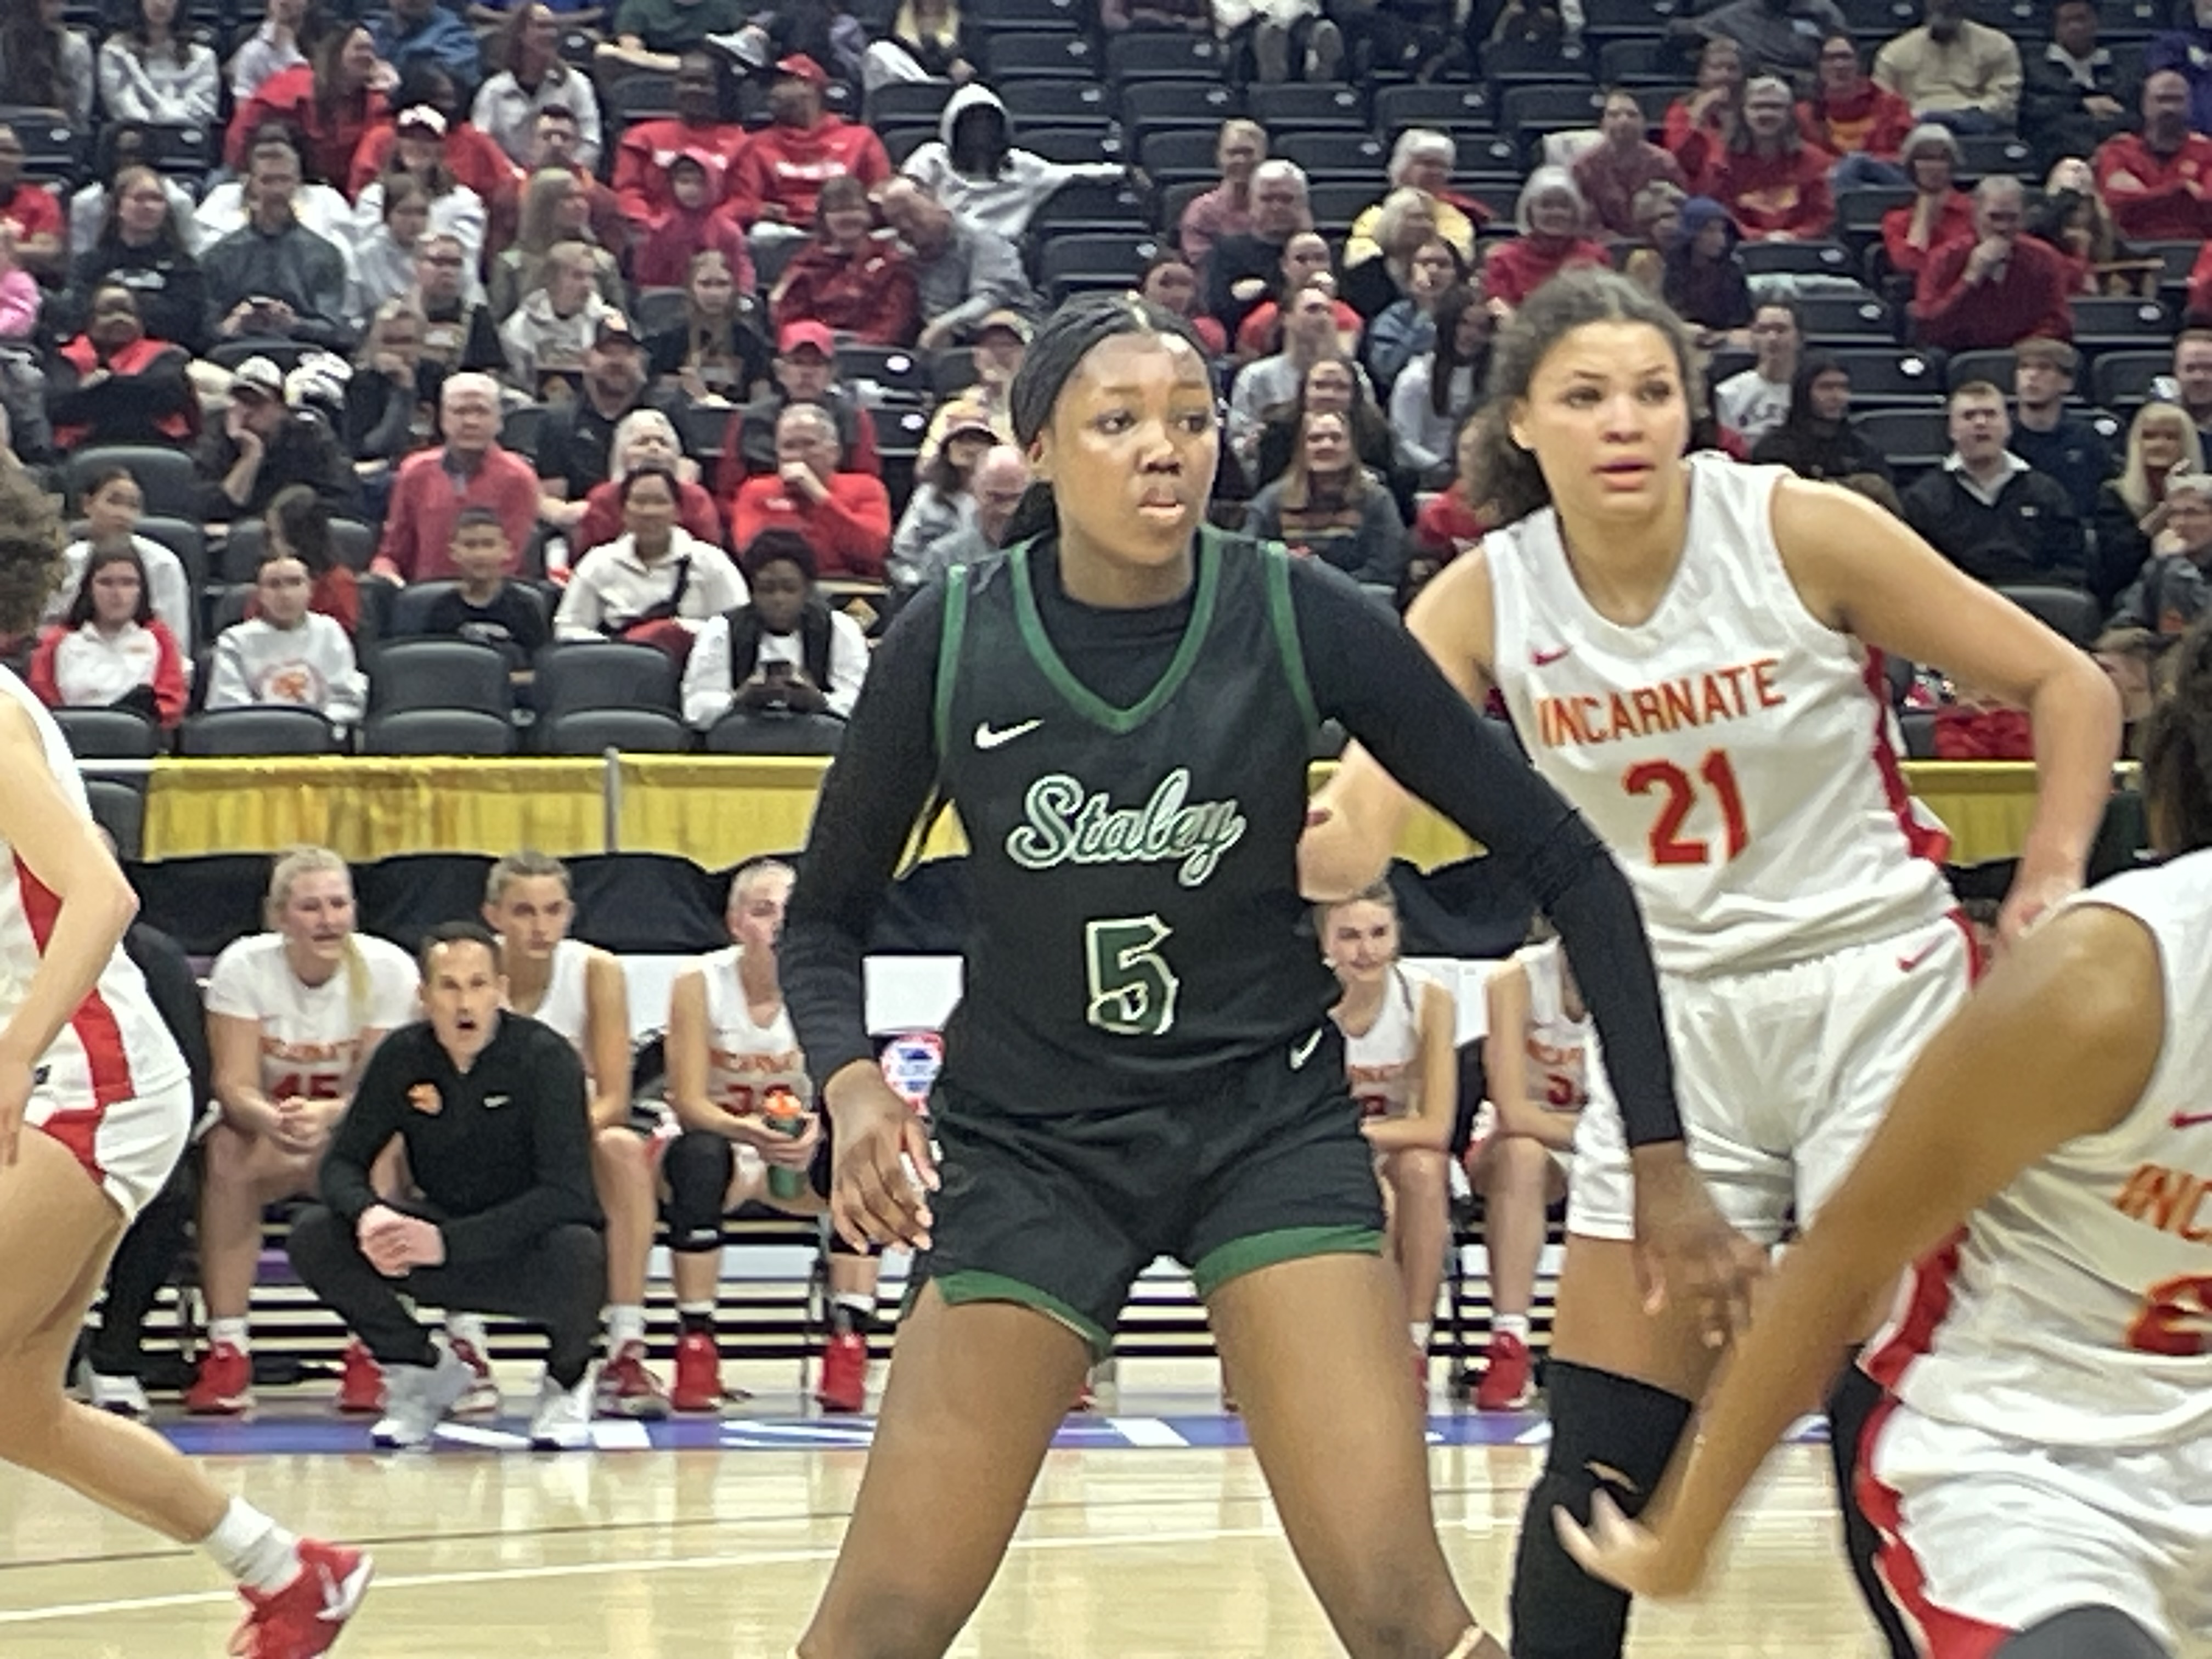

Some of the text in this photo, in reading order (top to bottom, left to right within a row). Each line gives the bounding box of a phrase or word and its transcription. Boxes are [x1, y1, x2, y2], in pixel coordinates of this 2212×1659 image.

[1539, 658, 1786, 747] INCARNATE
[1006, 769, 1246, 886] Staley
[1622, 749, 1750, 866] 21
[1086, 914, 1179, 1035] 5
